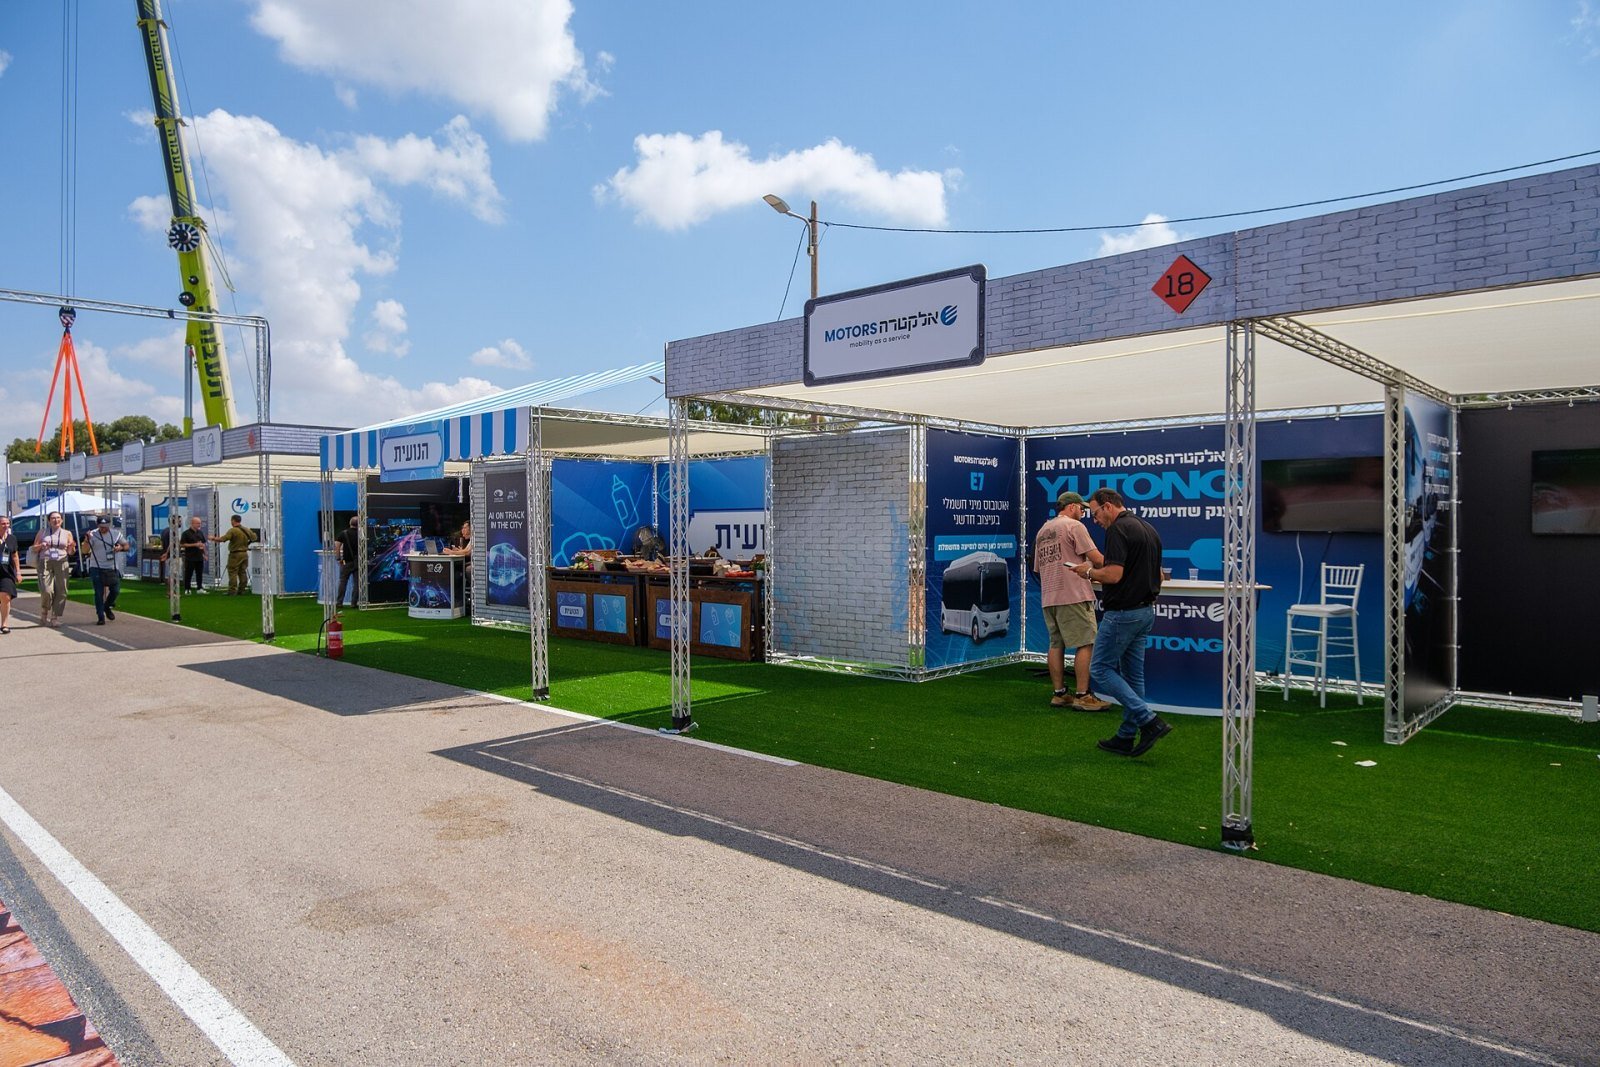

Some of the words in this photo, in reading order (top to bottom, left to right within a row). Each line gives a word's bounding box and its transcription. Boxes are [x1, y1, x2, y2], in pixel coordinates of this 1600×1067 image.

[150, 30, 164, 71] תעבורה
[167, 129, 182, 173] תעבורה
[1165, 272, 1194, 298] 18
[879, 311, 939, 333] אלקטרה
[824, 322, 878, 342] MOTORS
[849, 339, 874, 348] mobility
[888, 333, 911, 343] service
[393, 443, 429, 463] הנועית
[1035, 459, 1056, 471] את
[1059, 457, 1106, 470] מחזירה
[1110, 454, 1164, 467] MOTORS
[970, 472, 984, 491] E7
[942, 497, 967, 510] חשמלי
[968, 499, 982, 510] מיני
[983, 500, 1010, 510] אוטובוס
[488, 511, 495, 519] AI
[495, 511, 505, 519] ON
[505, 511, 525, 519] TRACK
[1140, 505, 1201, 518] שחישמל
[490, 521, 497, 529] IN
[497, 521, 508, 529] THE
[510, 521, 523, 529] CITY
[953, 514, 975, 525] חדשני
[976, 514, 1001, 525] בעיצוב
